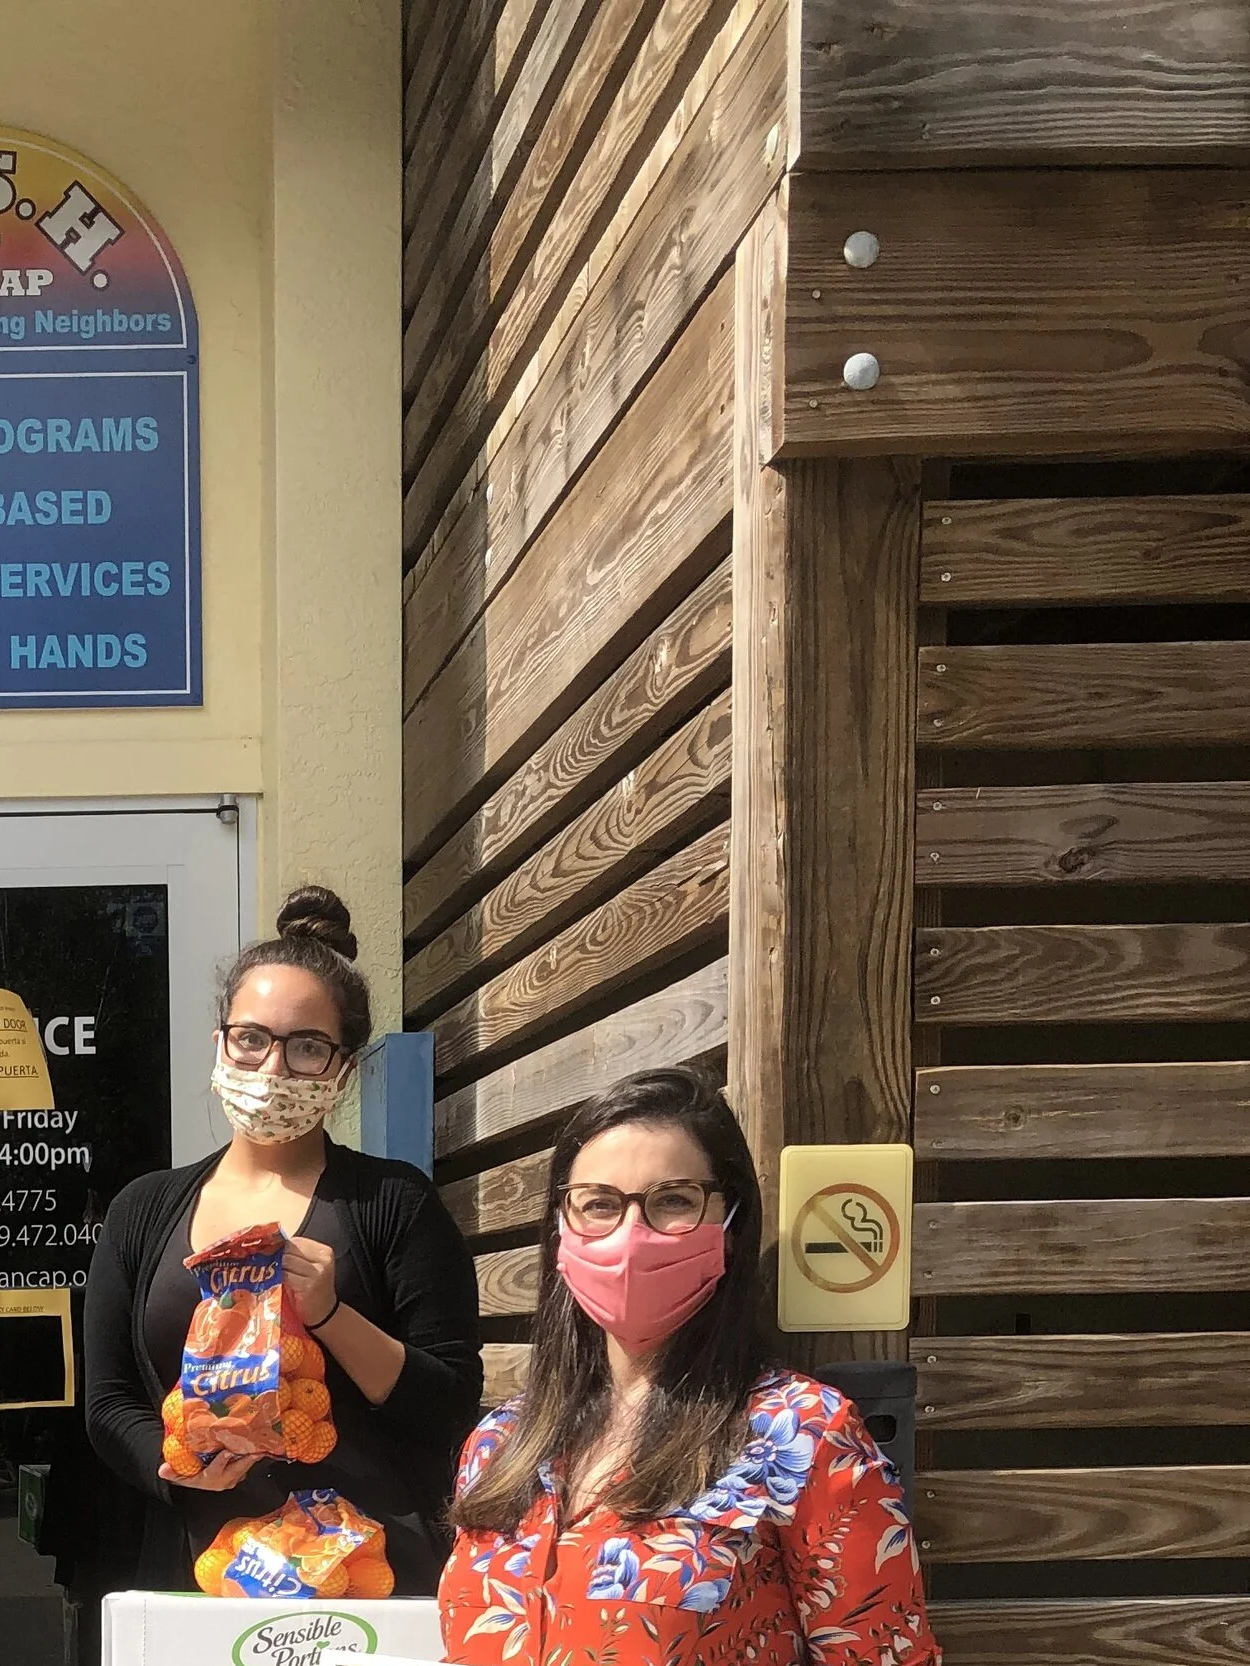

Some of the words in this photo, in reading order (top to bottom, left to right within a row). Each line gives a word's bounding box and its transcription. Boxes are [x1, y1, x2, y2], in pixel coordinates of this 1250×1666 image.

[34, 310, 172, 338] Neighbors
[10, 634, 147, 670] HANDS
[4, 1019, 26, 1029] DOOR
[3, 1110, 78, 1134] Friday
[211, 1261, 278, 1294] Citrus
[193, 1366, 270, 1396] Citrus
[235, 1556, 301, 1597] Citrus
[253, 1615, 342, 1654] Sensible
